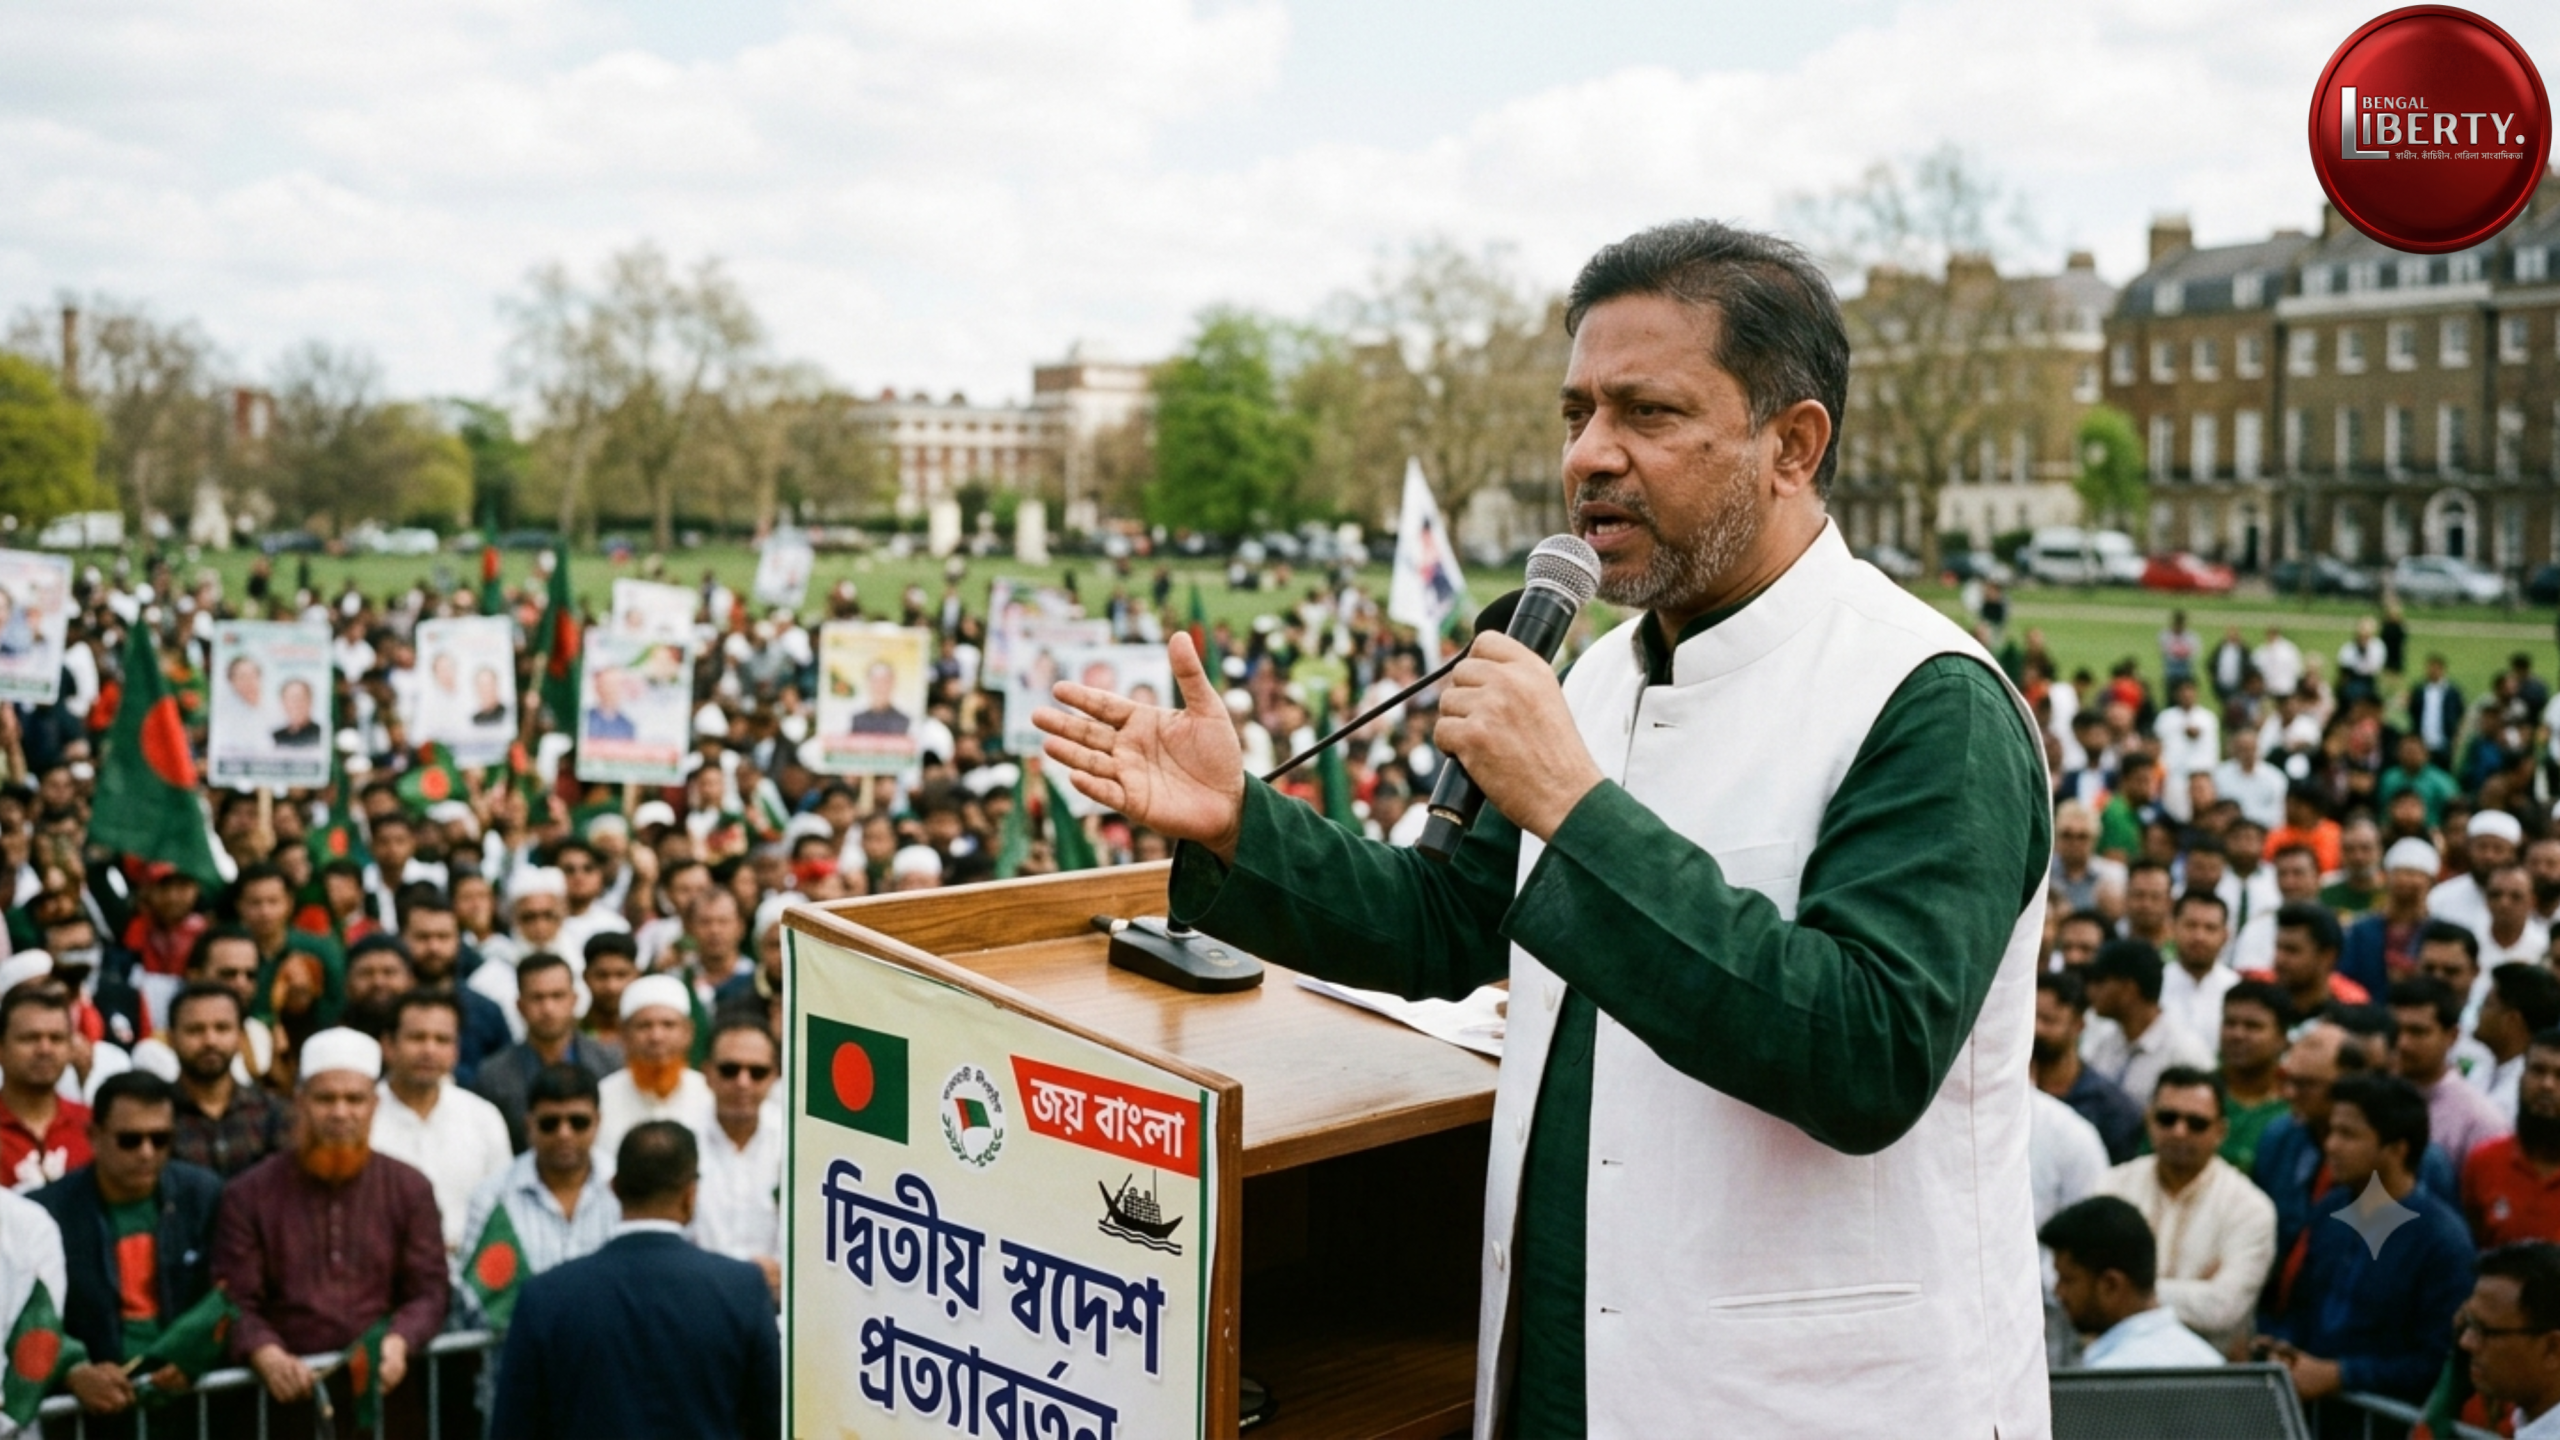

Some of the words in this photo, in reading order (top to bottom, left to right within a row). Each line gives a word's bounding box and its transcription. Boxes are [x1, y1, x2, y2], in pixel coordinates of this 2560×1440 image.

[1030, 1078, 1087, 1136] জয়
[1094, 1094, 1186, 1158] বাংলা
[822, 1159, 986, 1318] দ্বিতীয়
[1000, 1239, 1165, 1375] স্বদেশ
